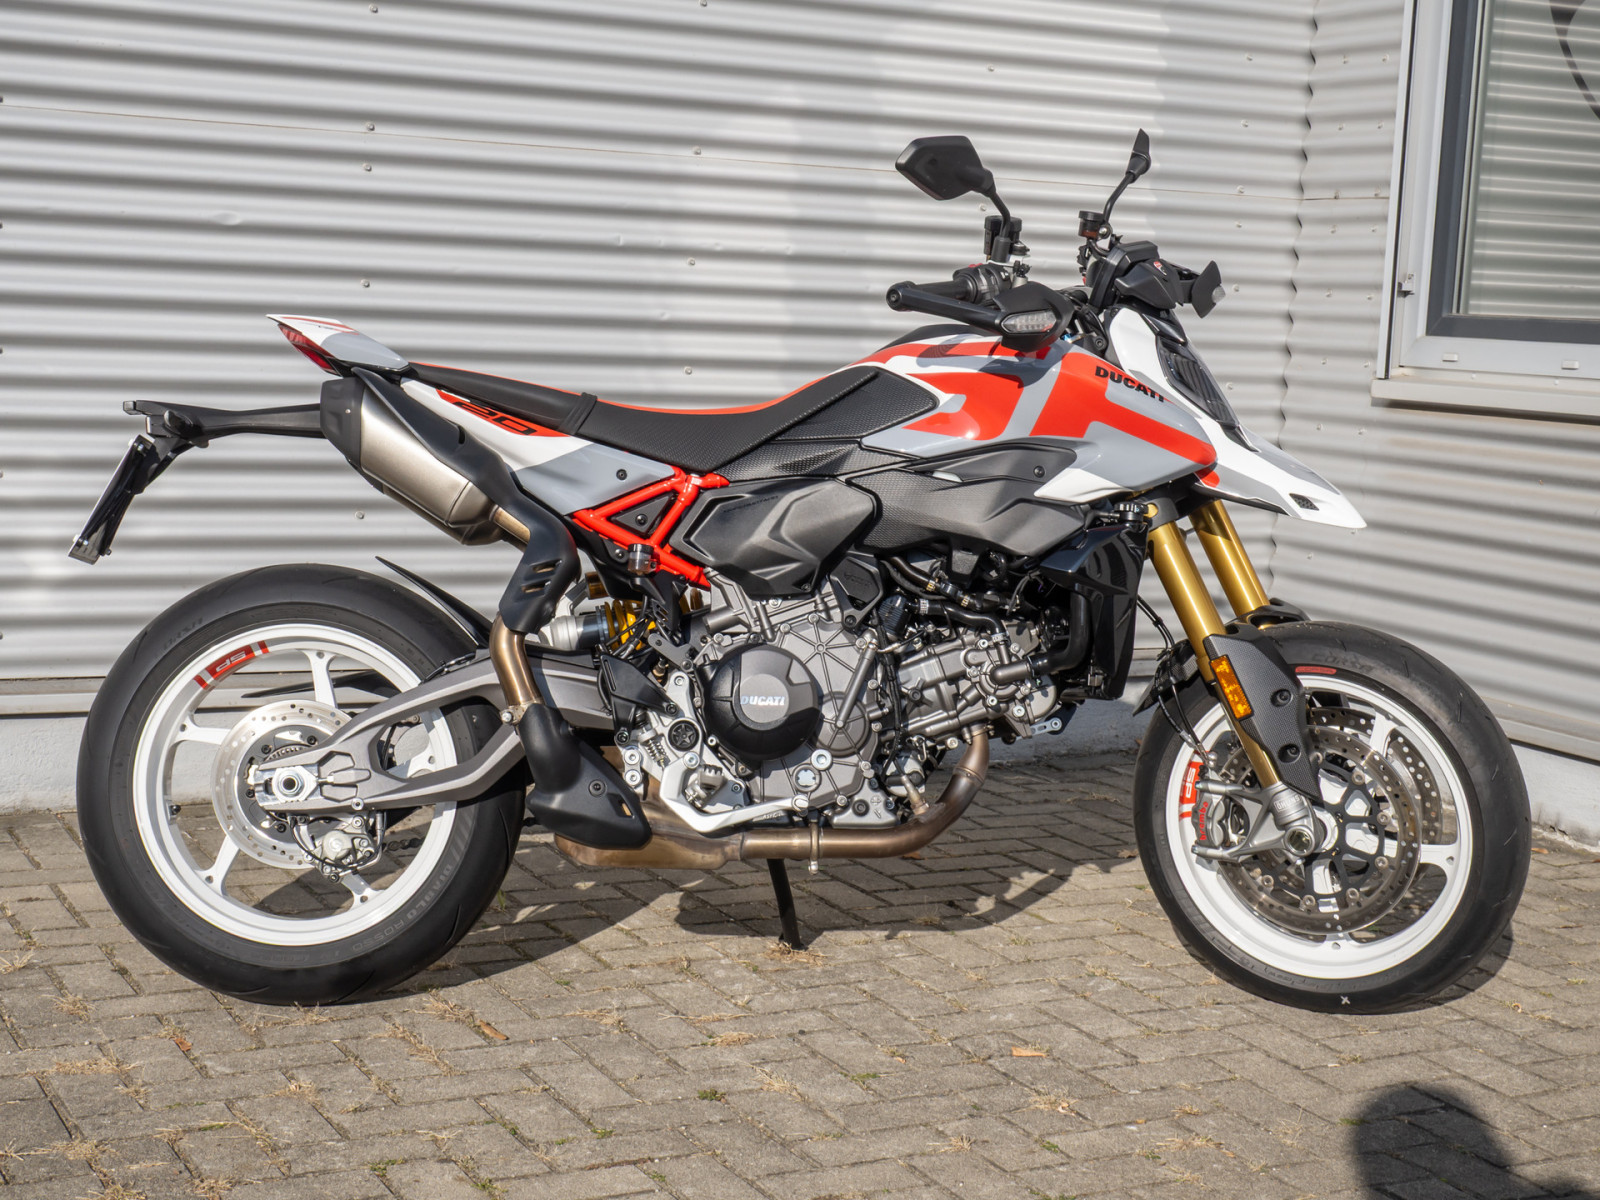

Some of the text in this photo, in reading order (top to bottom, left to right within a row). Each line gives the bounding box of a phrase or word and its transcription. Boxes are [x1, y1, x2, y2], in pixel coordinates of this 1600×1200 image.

[1095, 365, 1164, 403] DUCATI
[215, 650, 246, 673] SP
[740, 695, 785, 706] DUCATI
[1185, 767, 1196, 798] SP
[1199, 801, 1208, 840] brembo
[352, 863, 453, 952] DIABLO ROSSO
